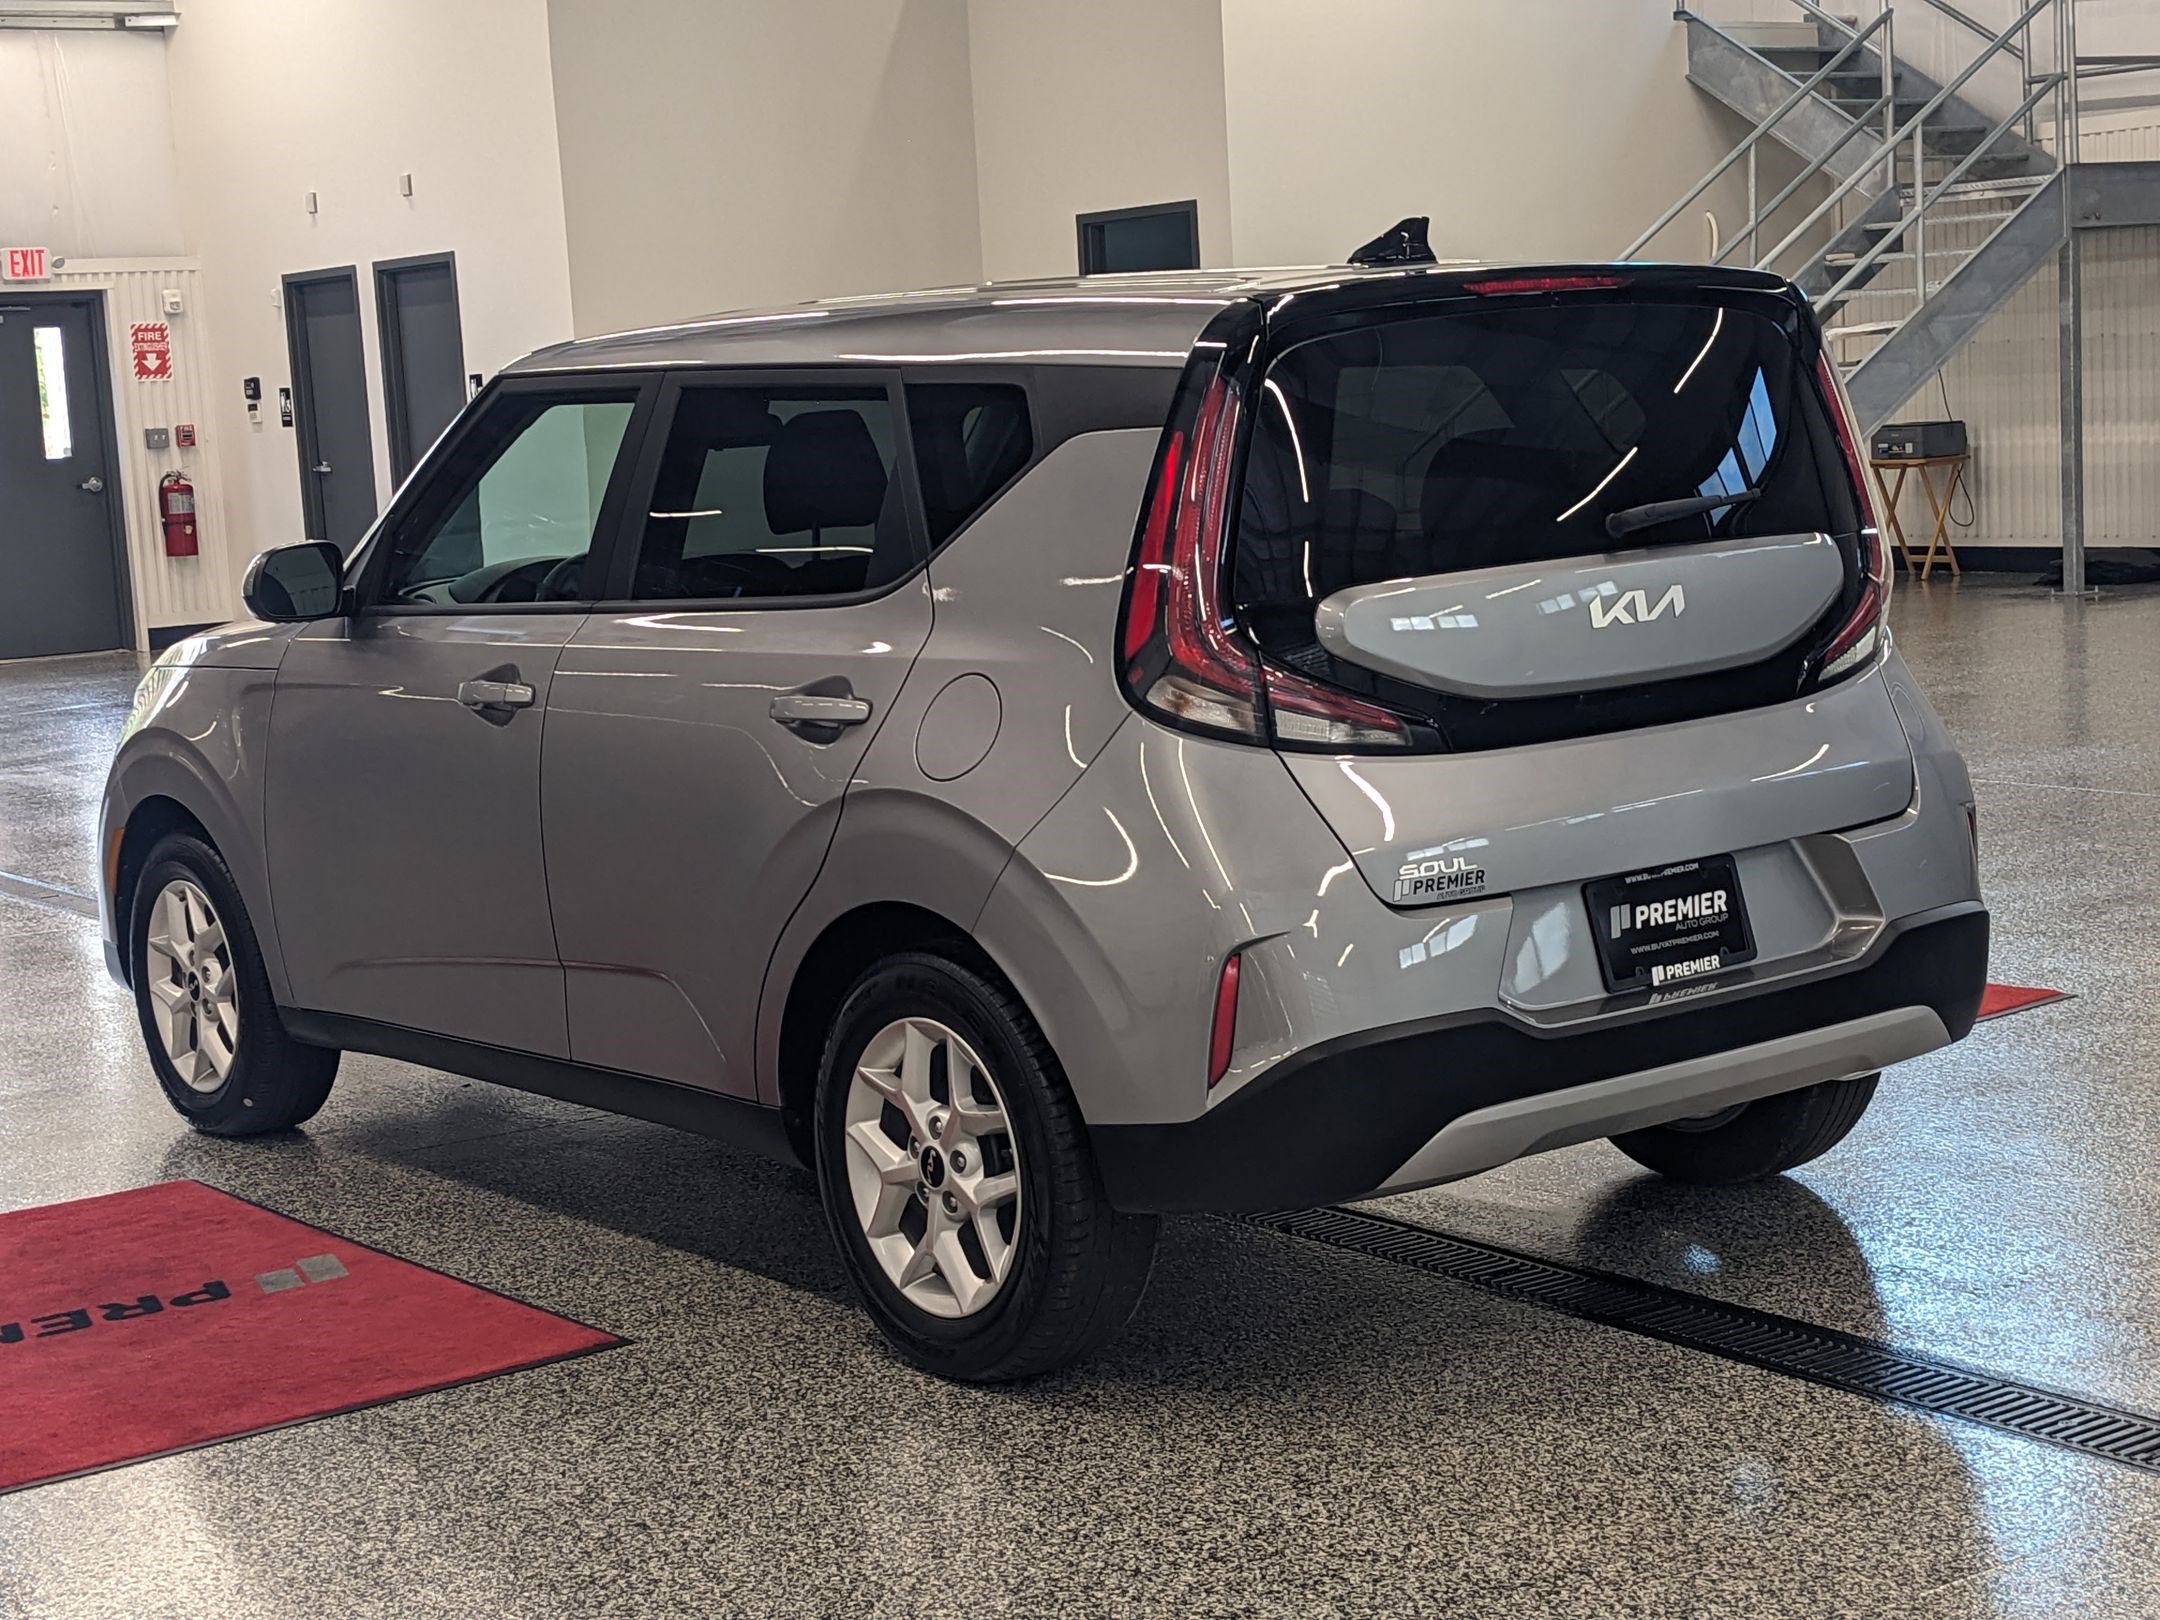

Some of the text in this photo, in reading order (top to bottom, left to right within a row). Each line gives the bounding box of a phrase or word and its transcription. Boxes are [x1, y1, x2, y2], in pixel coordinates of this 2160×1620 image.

[10, 249, 44, 277] EXIT
[137, 331, 162, 341] FIRE
[1589, 584, 1685, 629] KIA
[1399, 856, 1478, 880] SOUL
[1413, 869, 1485, 895] PREMIER
[1635, 889, 1728, 930] PREMIER
[1675, 912, 1729, 931] AUTO GROUP
[1665, 954, 1721, 980] PREMIER
